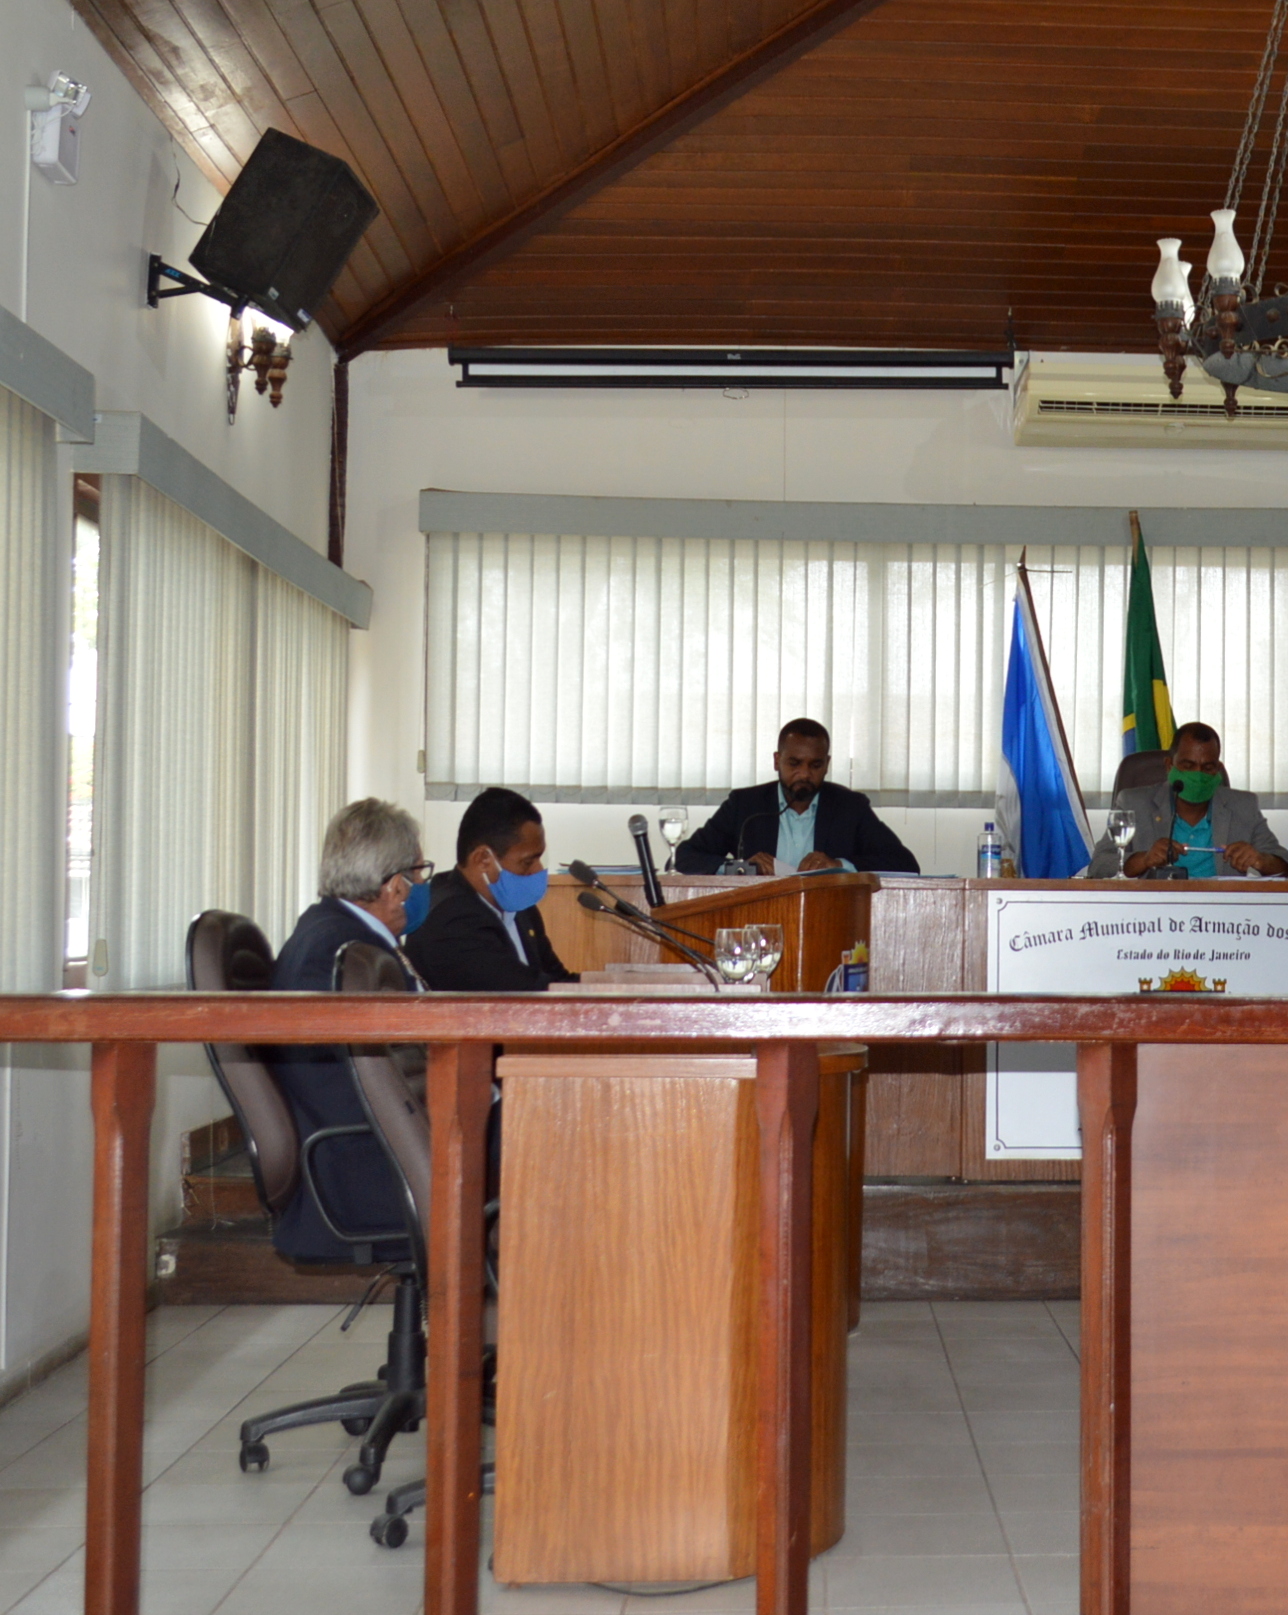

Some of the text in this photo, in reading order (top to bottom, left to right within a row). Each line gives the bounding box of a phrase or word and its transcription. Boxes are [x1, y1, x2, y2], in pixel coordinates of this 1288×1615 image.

[1009, 928, 1074, 952] Câmara
[1079, 916, 1163, 941] Municipal
[1169, 918, 1186, 933] de
[1189, 915, 1260, 941] Armação
[1116, 949, 1251, 962] Estado do Rio de Janeiro
